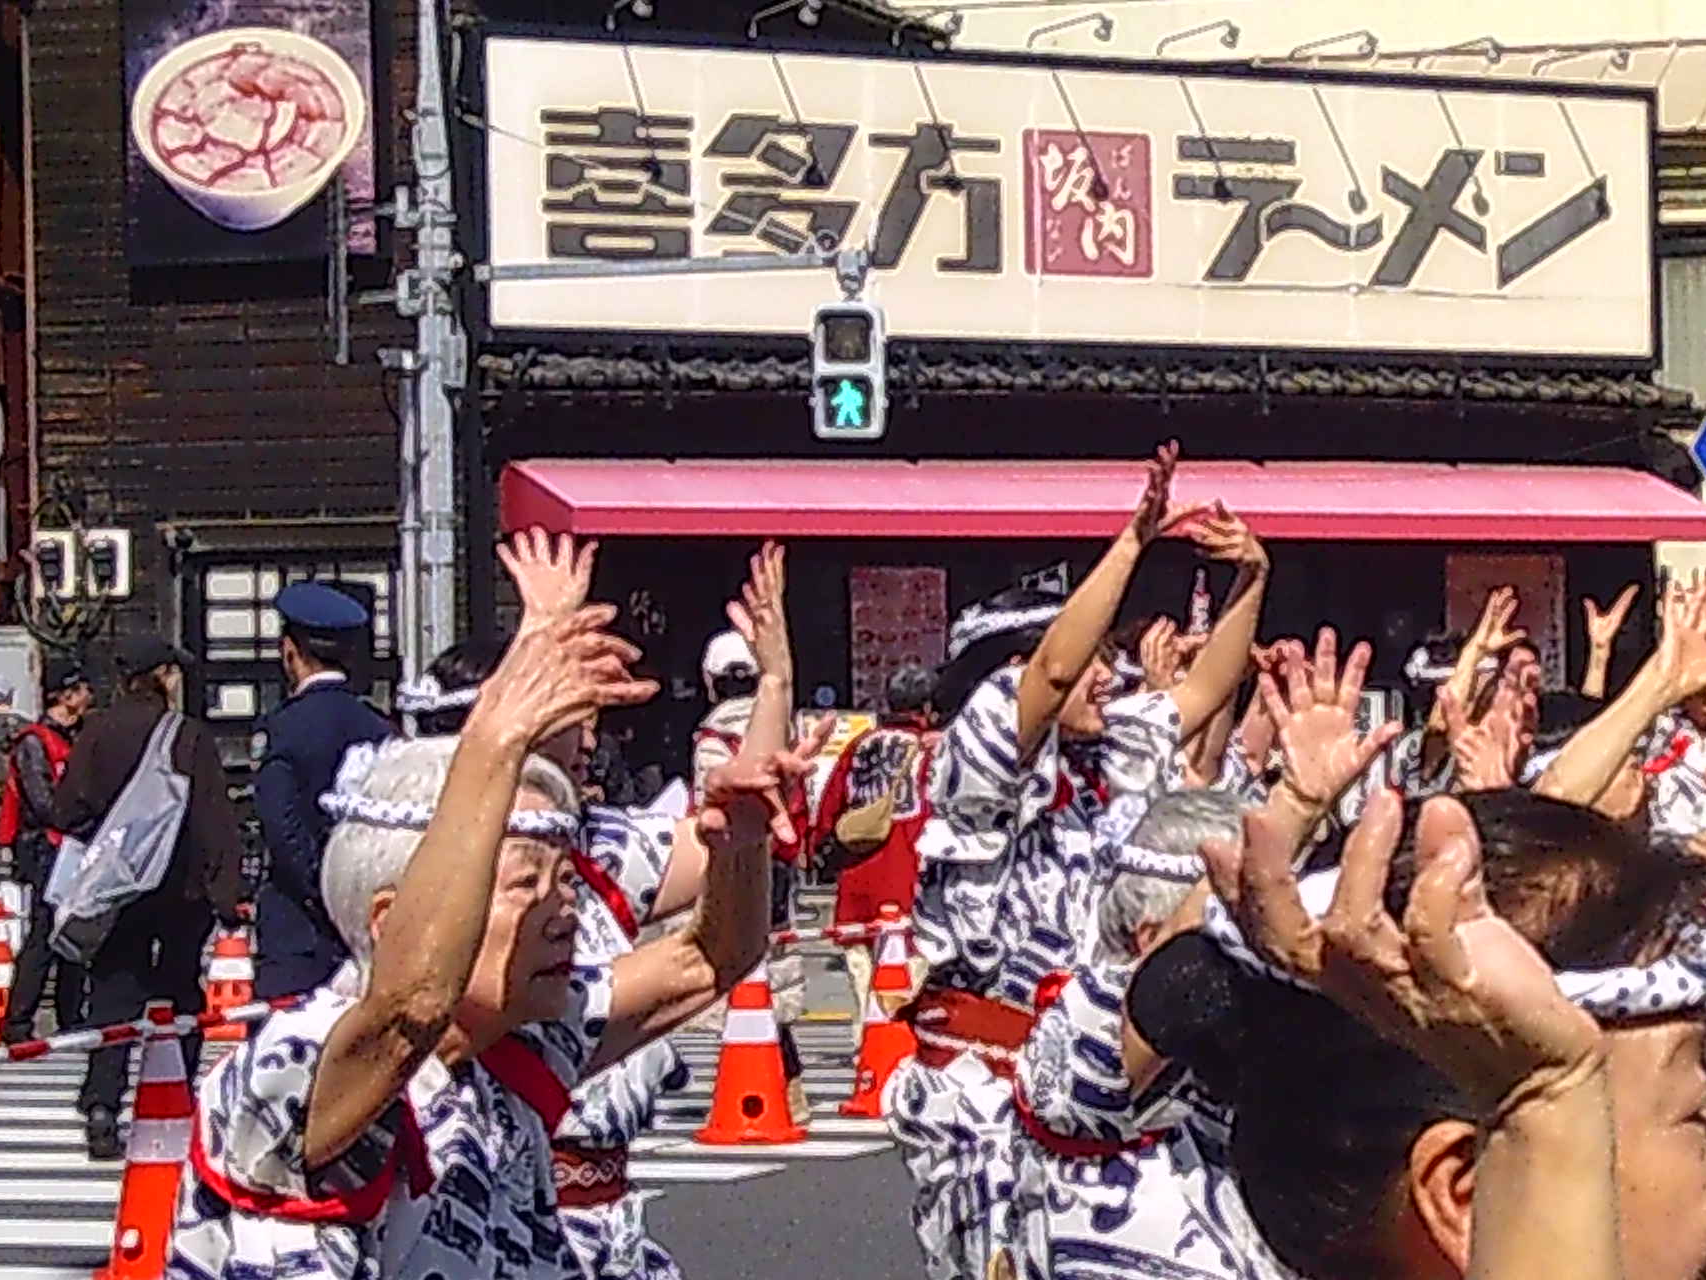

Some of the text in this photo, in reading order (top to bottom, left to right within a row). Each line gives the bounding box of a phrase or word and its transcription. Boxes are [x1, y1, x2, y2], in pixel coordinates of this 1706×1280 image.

[538, 106, 1003, 276] 喜多方
[1172, 132, 1613, 290] ラーメン
